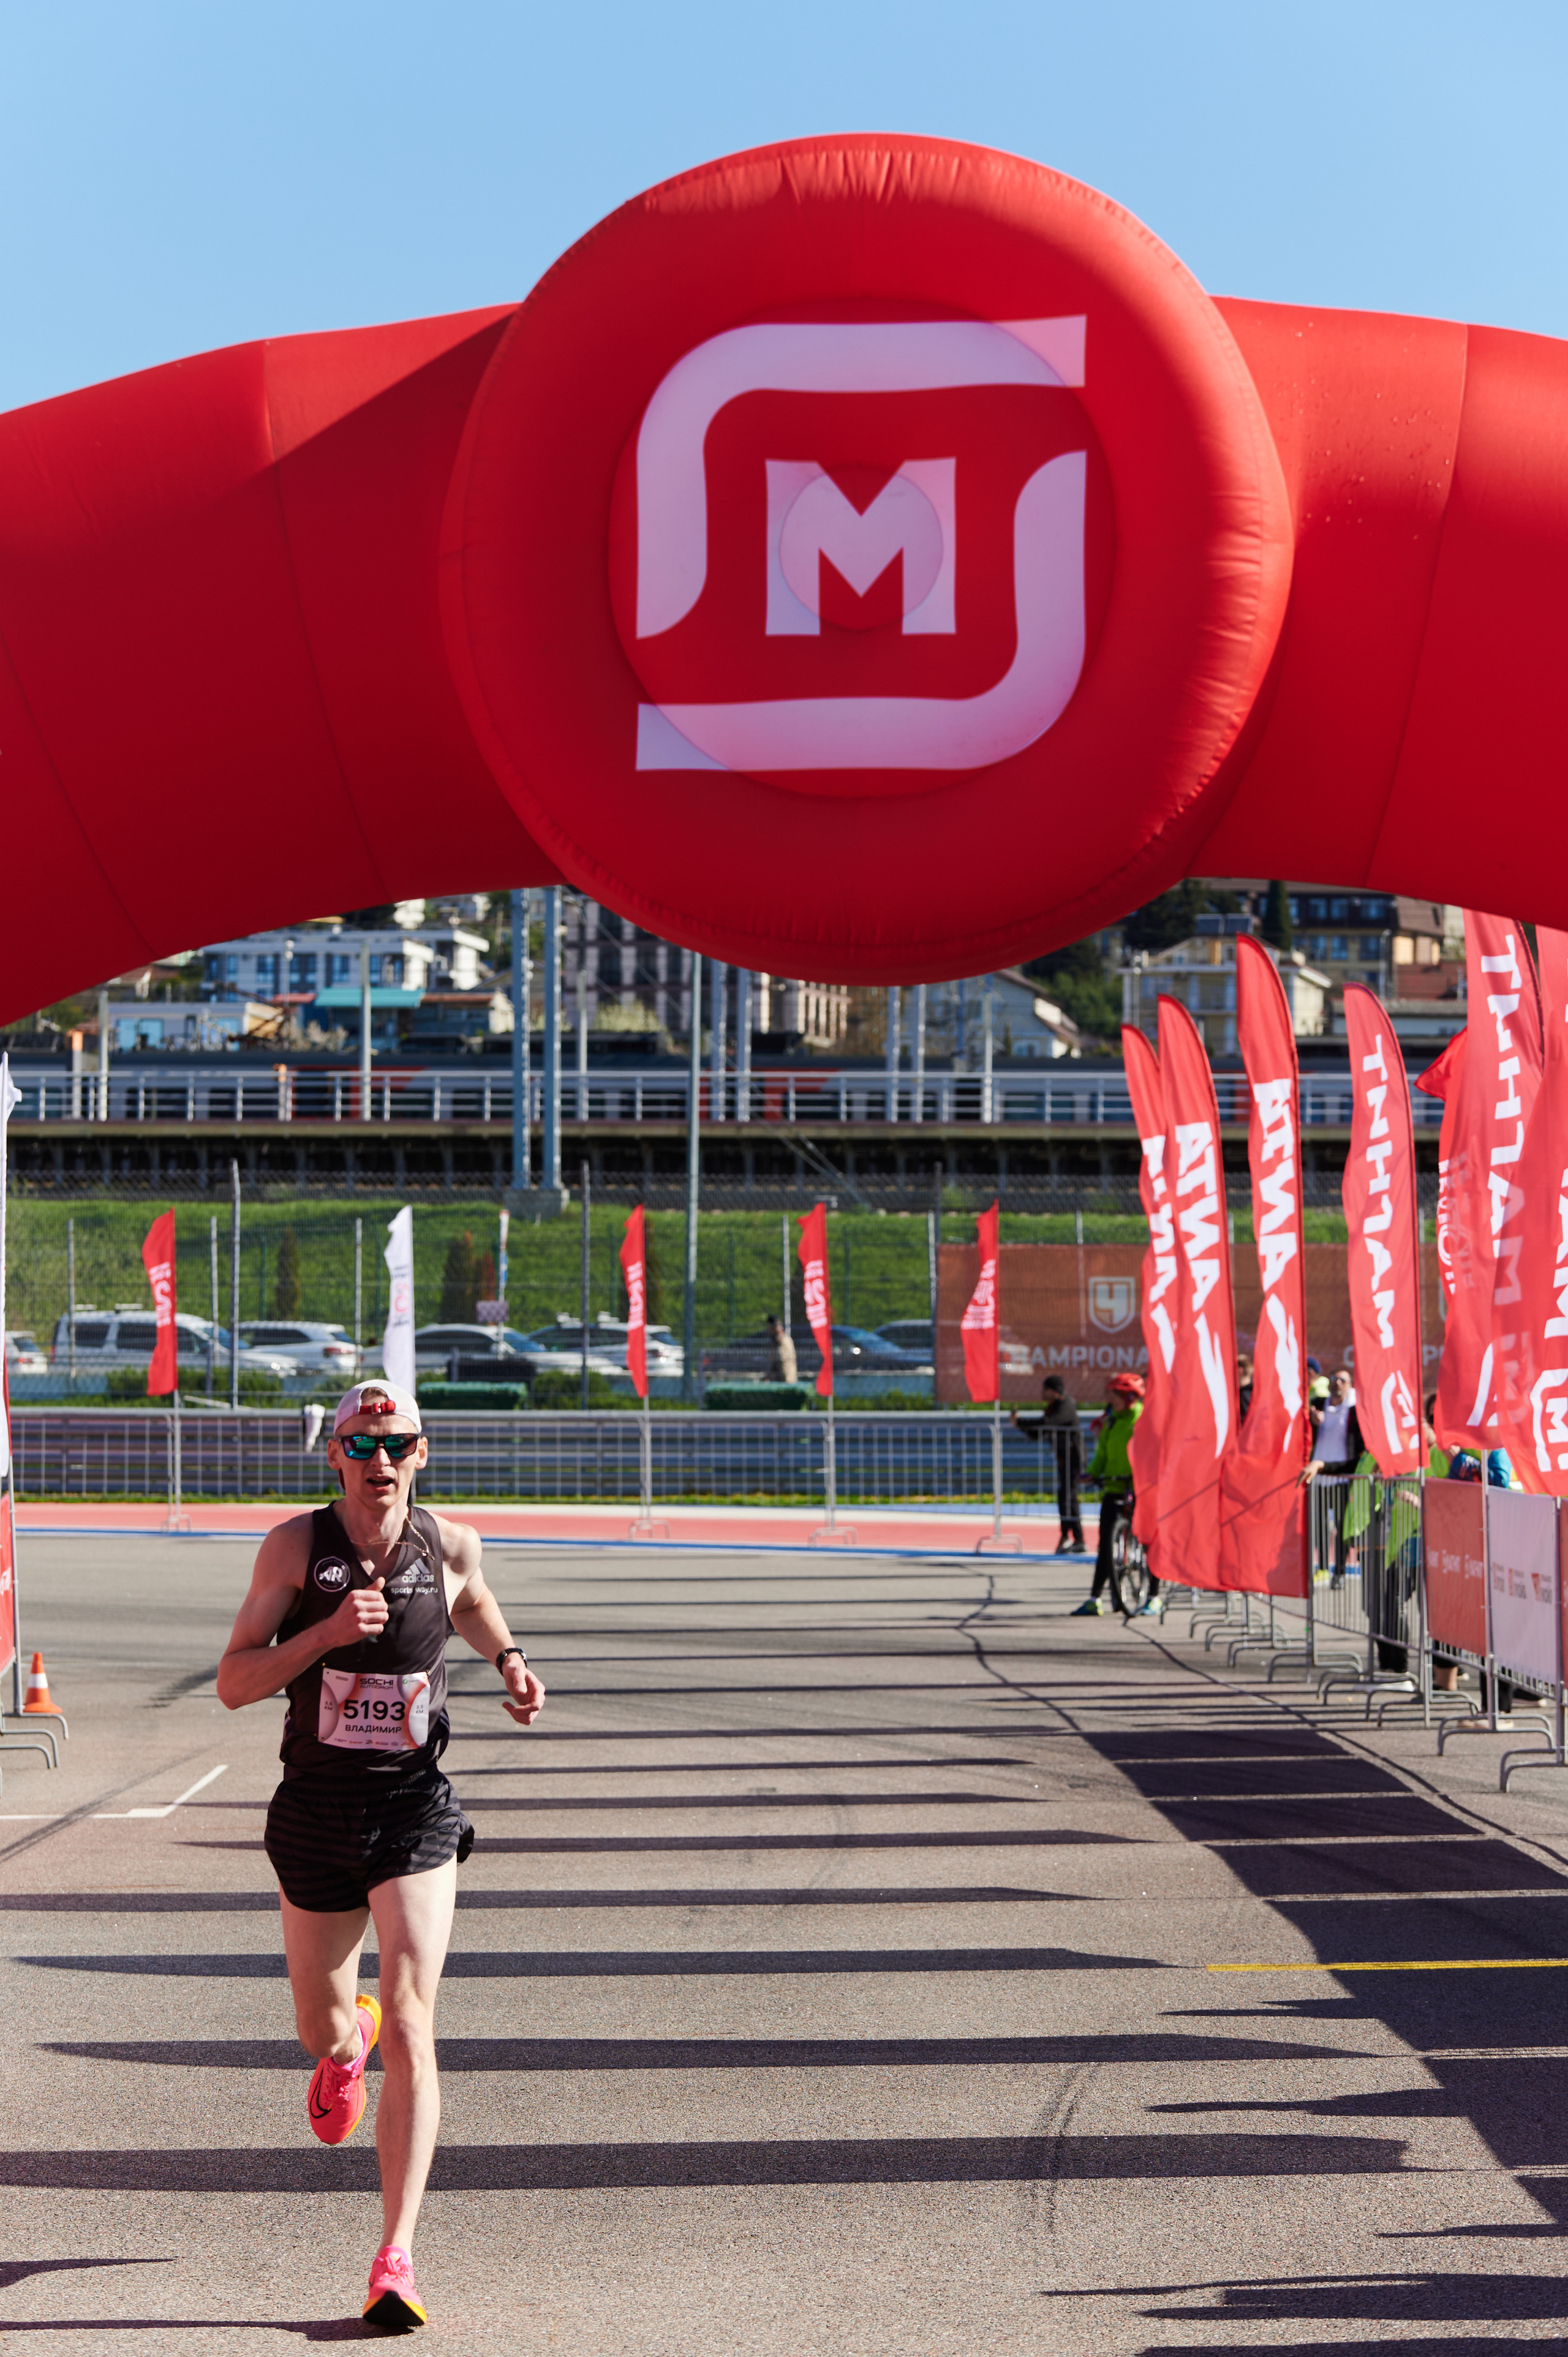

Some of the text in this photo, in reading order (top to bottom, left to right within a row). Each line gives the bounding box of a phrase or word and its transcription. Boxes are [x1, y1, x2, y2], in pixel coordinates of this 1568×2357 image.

[402, 1573, 435, 1583] adidas
[343, 1699, 406, 1721] 5193
[345, 1724, 402, 1733] ВЛАДИМИР
